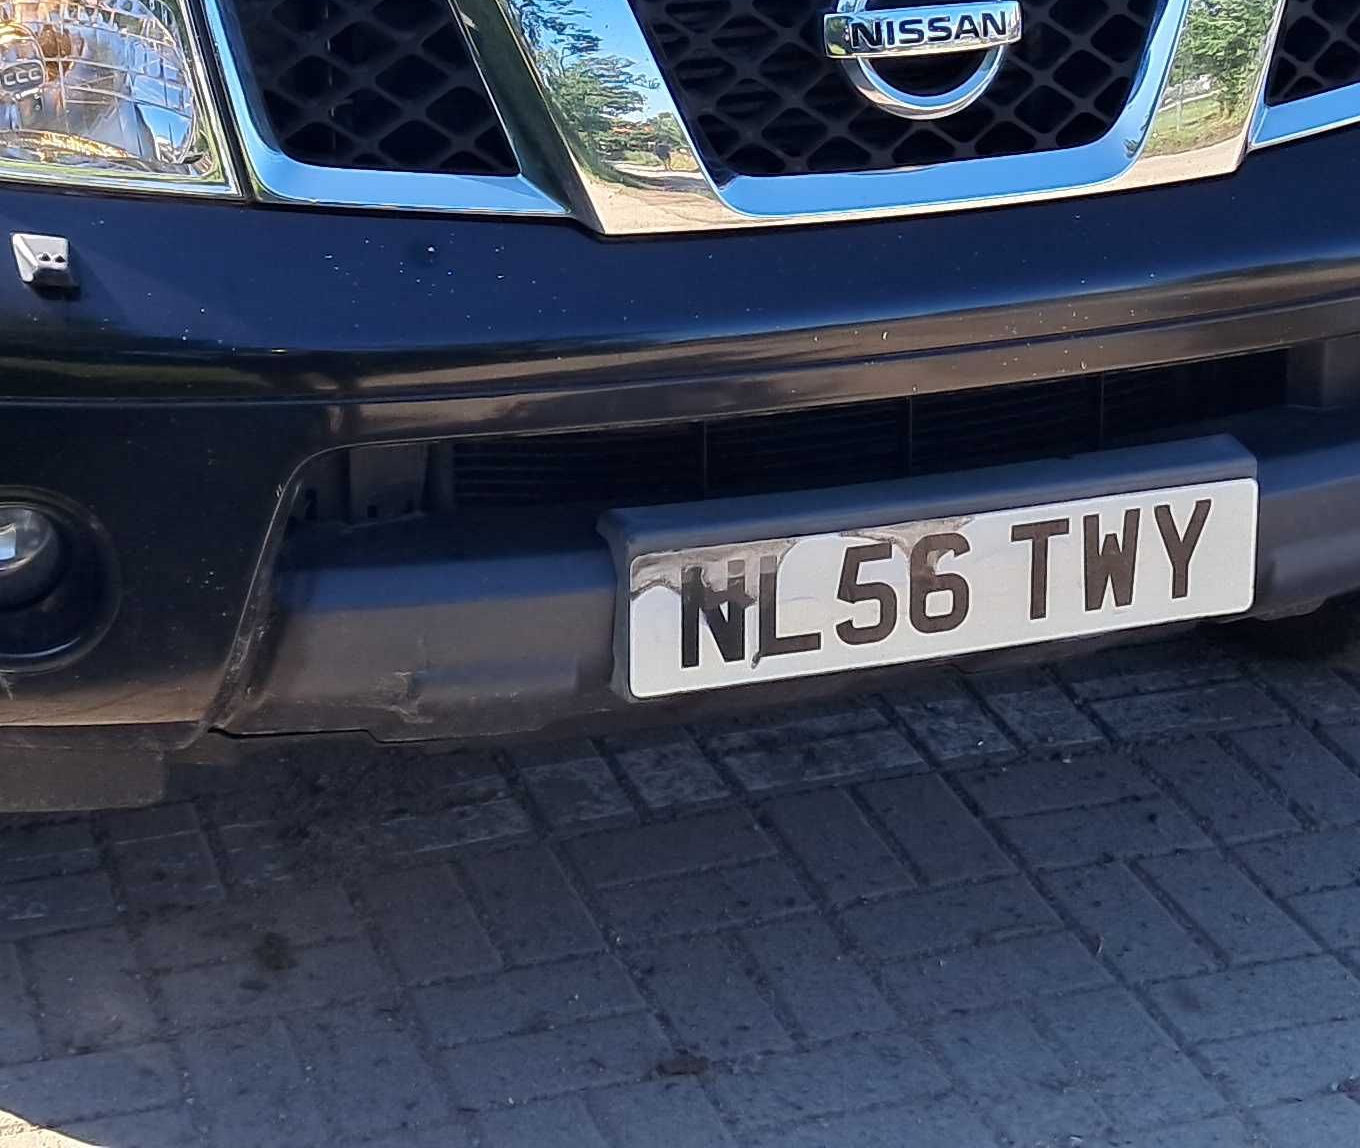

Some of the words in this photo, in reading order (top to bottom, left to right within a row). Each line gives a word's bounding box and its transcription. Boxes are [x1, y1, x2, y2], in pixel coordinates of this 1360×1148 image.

[850, 10, 1007, 48] NISSAN
[681, 532, 971, 669] NL56
[1010, 498, 1214, 621] TWY
